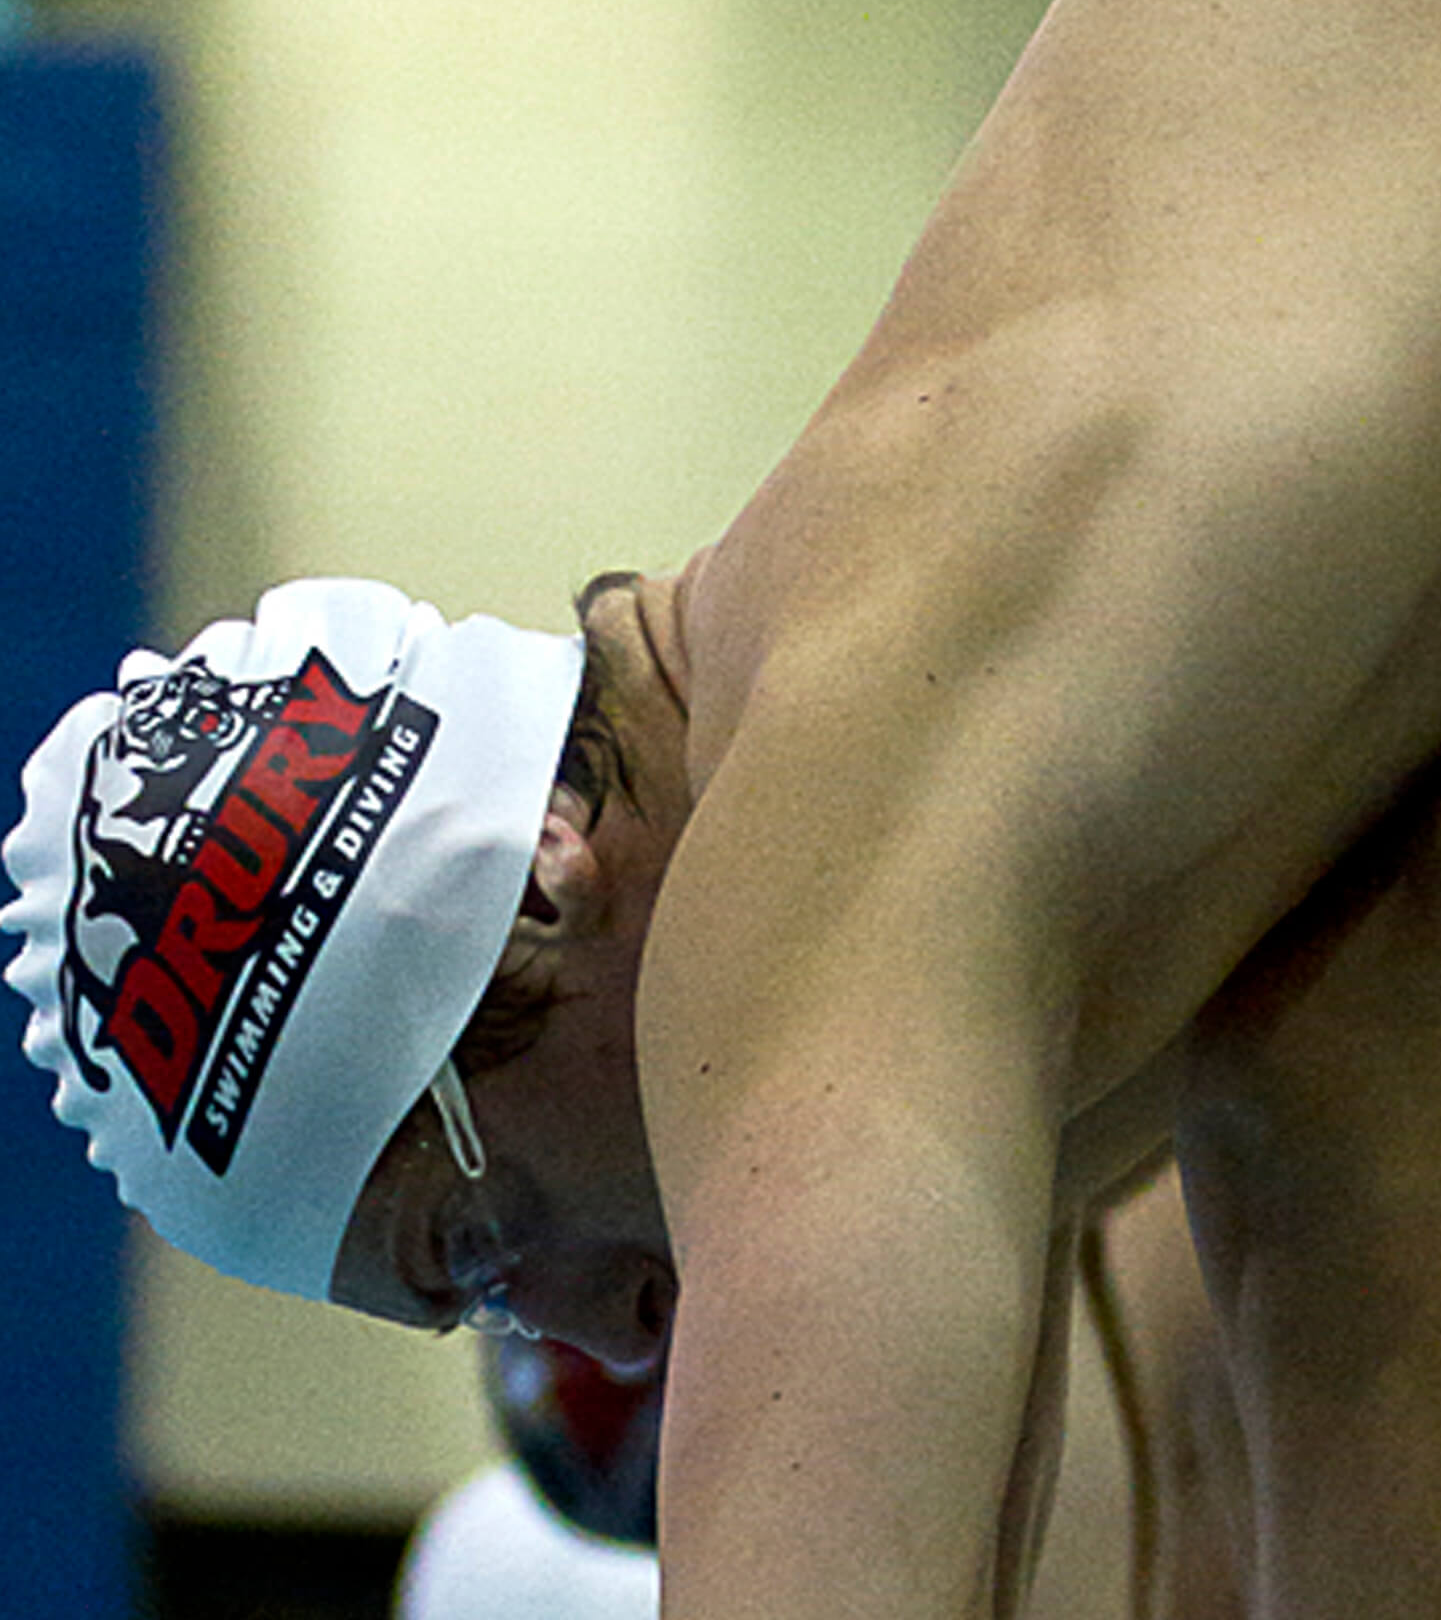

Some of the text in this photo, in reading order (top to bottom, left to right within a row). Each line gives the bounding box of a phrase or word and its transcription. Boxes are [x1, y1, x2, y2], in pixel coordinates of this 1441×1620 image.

[108, 661, 372, 1112] DRURY
[204, 722, 422, 1137] SWIMMING & DIVING
